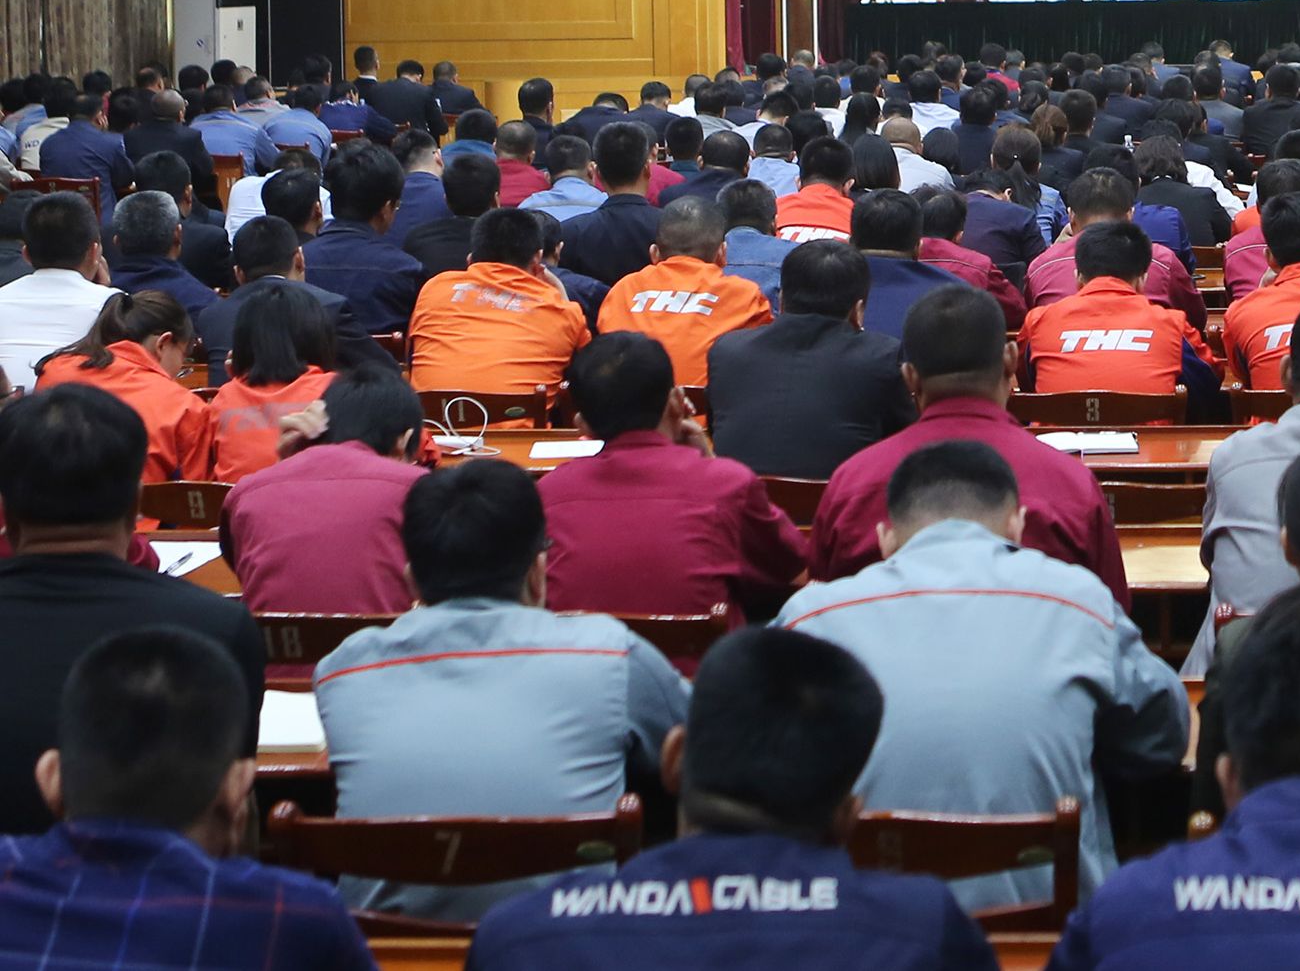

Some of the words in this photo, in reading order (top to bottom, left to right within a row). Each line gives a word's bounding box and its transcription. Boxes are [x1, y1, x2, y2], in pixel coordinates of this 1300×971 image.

[630, 290, 720, 316] THC
[1059, 329, 1154, 353] THC
[434, 830, 463, 876] 7
[551, 879, 693, 918] WANDA
[712, 874, 838, 912] CABLE
